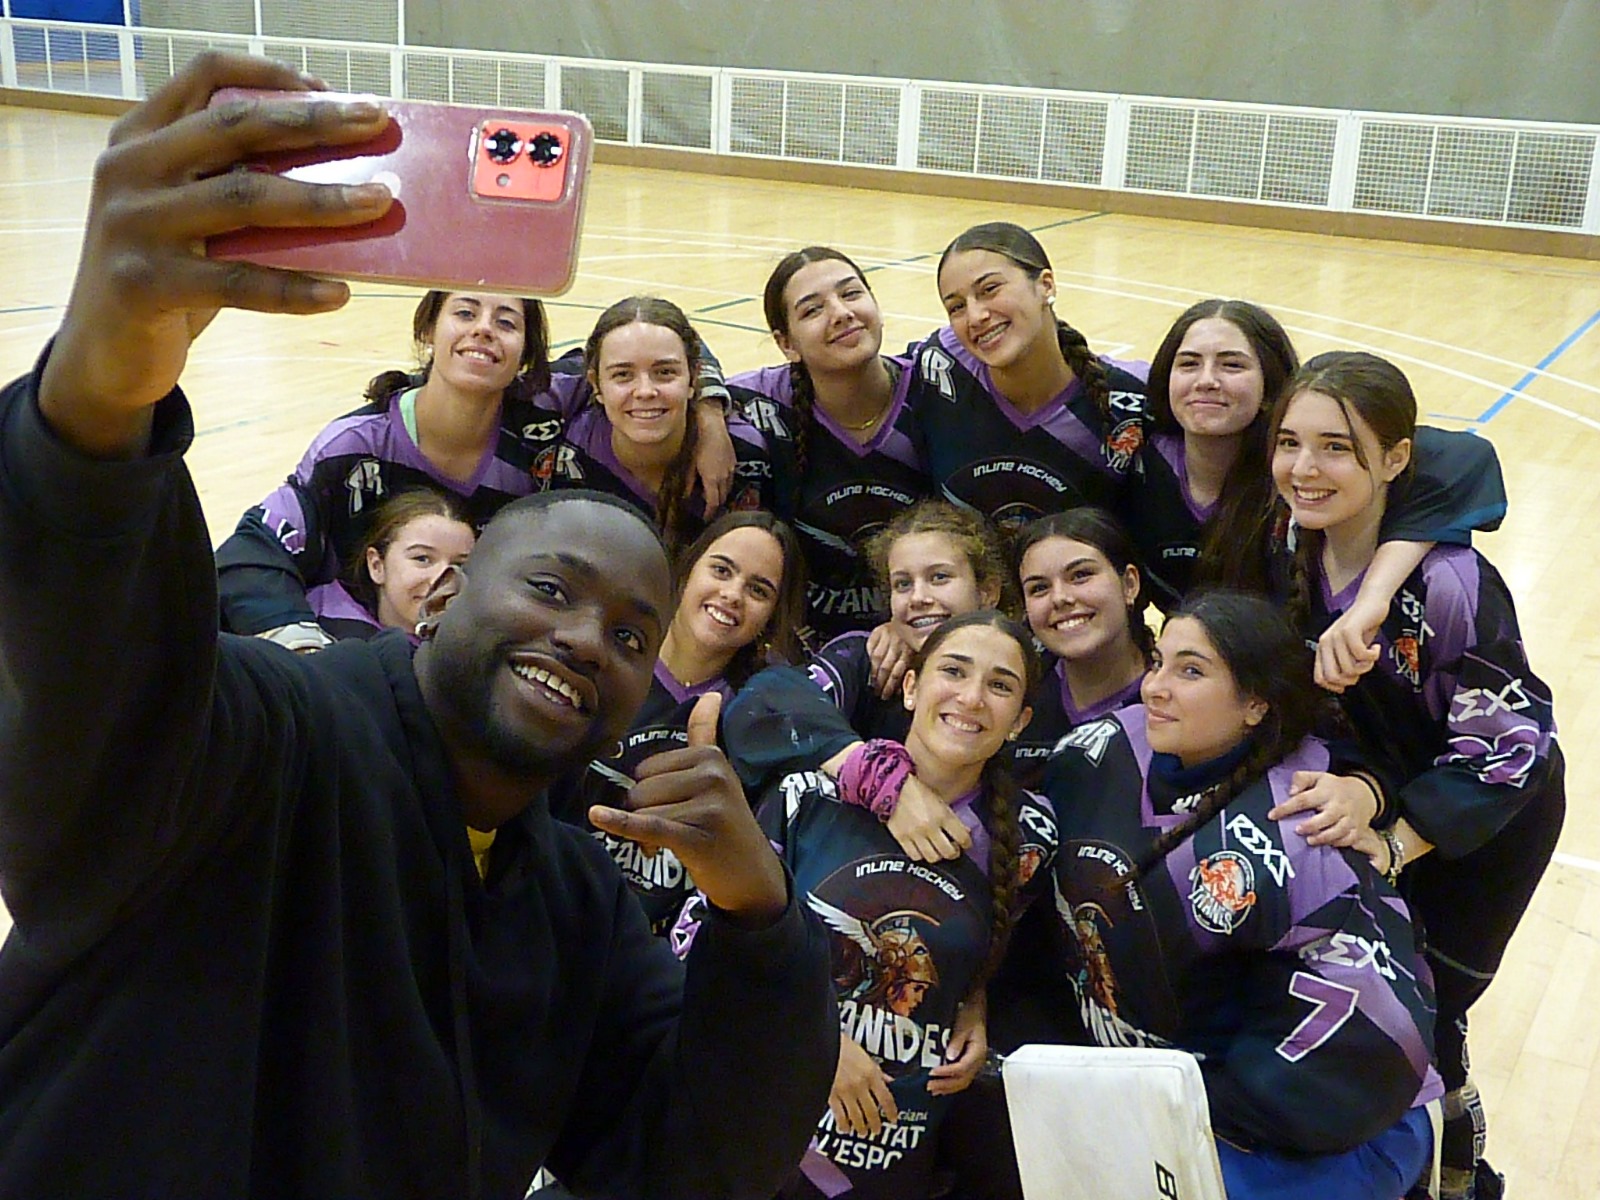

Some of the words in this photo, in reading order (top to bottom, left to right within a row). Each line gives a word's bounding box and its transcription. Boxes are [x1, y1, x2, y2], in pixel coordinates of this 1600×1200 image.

[973, 462, 1015, 478] INLINE
[1017, 463, 1068, 493] HOCKEY
[826, 485, 863, 505] INLINE
[865, 485, 915, 506] HOCKEY
[629, 729, 669, 747] INLINE
[856, 860, 905, 878] INLINE
[906, 863, 965, 901] HOCKEY
[1274, 970, 1360, 1063] 7
